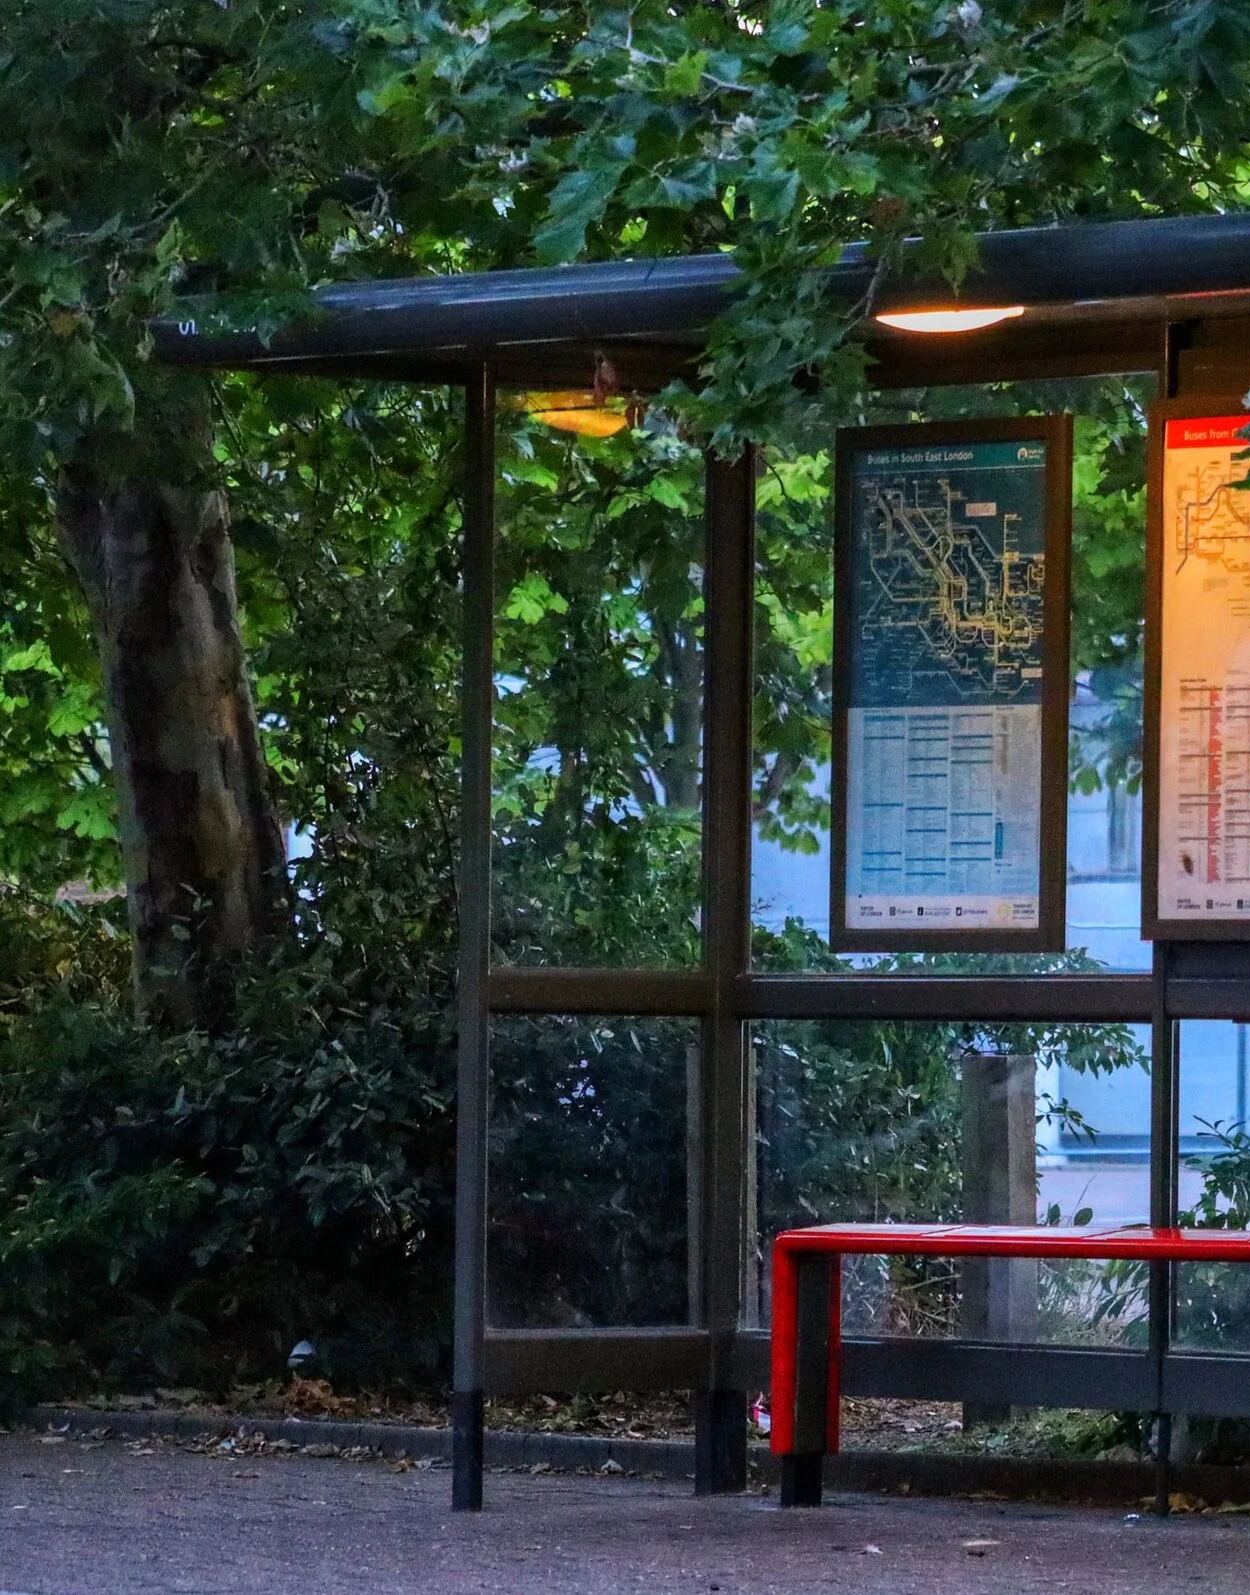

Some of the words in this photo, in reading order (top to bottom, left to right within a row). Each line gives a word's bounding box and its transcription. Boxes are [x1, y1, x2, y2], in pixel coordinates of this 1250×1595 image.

[1184, 430, 1208, 442] Buses
[1209, 429, 1230, 441] from
[867, 454, 890, 466] Buses
[891, 454, 900, 464] in
[901, 452, 924, 463] South
[925, 451, 942, 462] East
[943, 450, 973, 462] London
